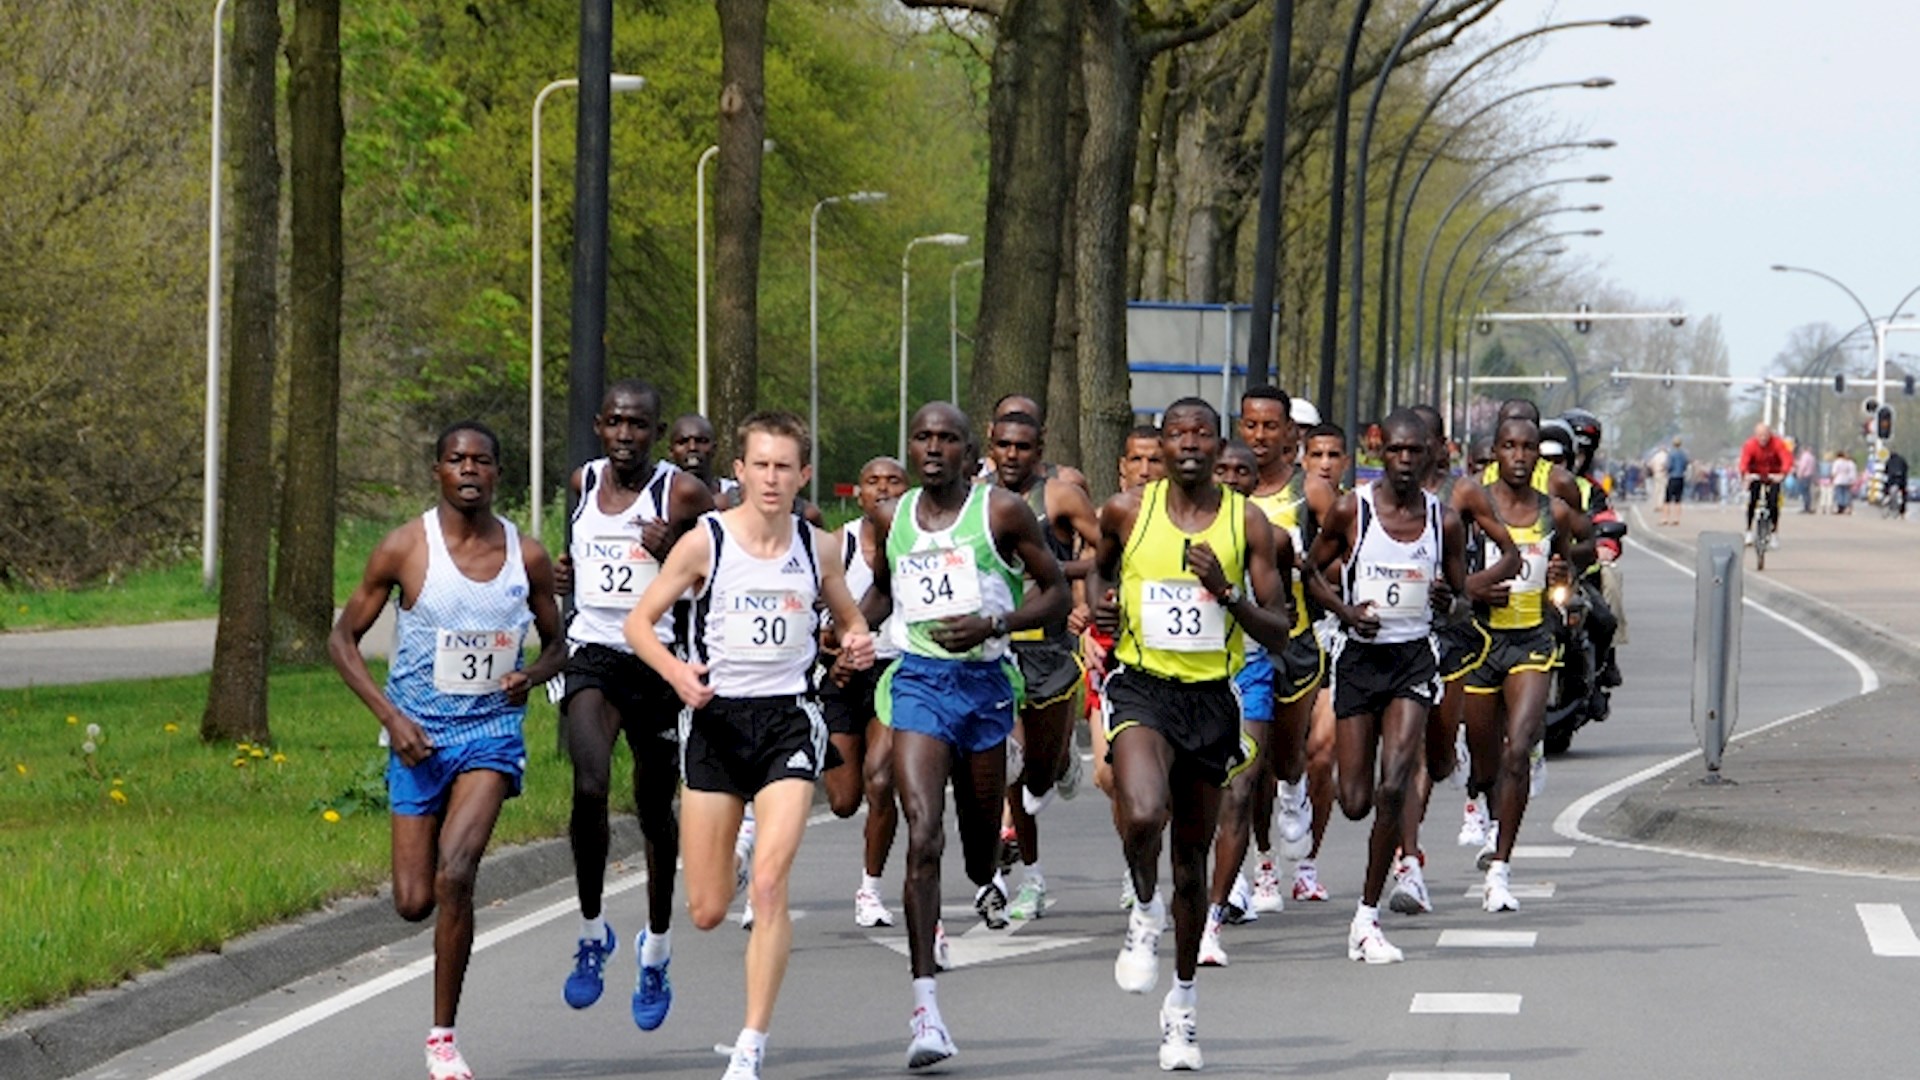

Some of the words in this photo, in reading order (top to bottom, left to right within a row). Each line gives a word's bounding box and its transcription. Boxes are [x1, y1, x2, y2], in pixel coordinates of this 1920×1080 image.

[585, 542, 622, 560] ING
[600, 563, 632, 592] 32
[920, 573, 953, 605] 34
[735, 596, 777, 612] ING
[1150, 586, 1192, 603] ING
[1386, 583, 1400, 607] 6
[752, 616, 787, 646] 30
[1167, 606, 1201, 636] 33
[445, 633, 487, 650] ING
[461, 653, 494, 680] 31
